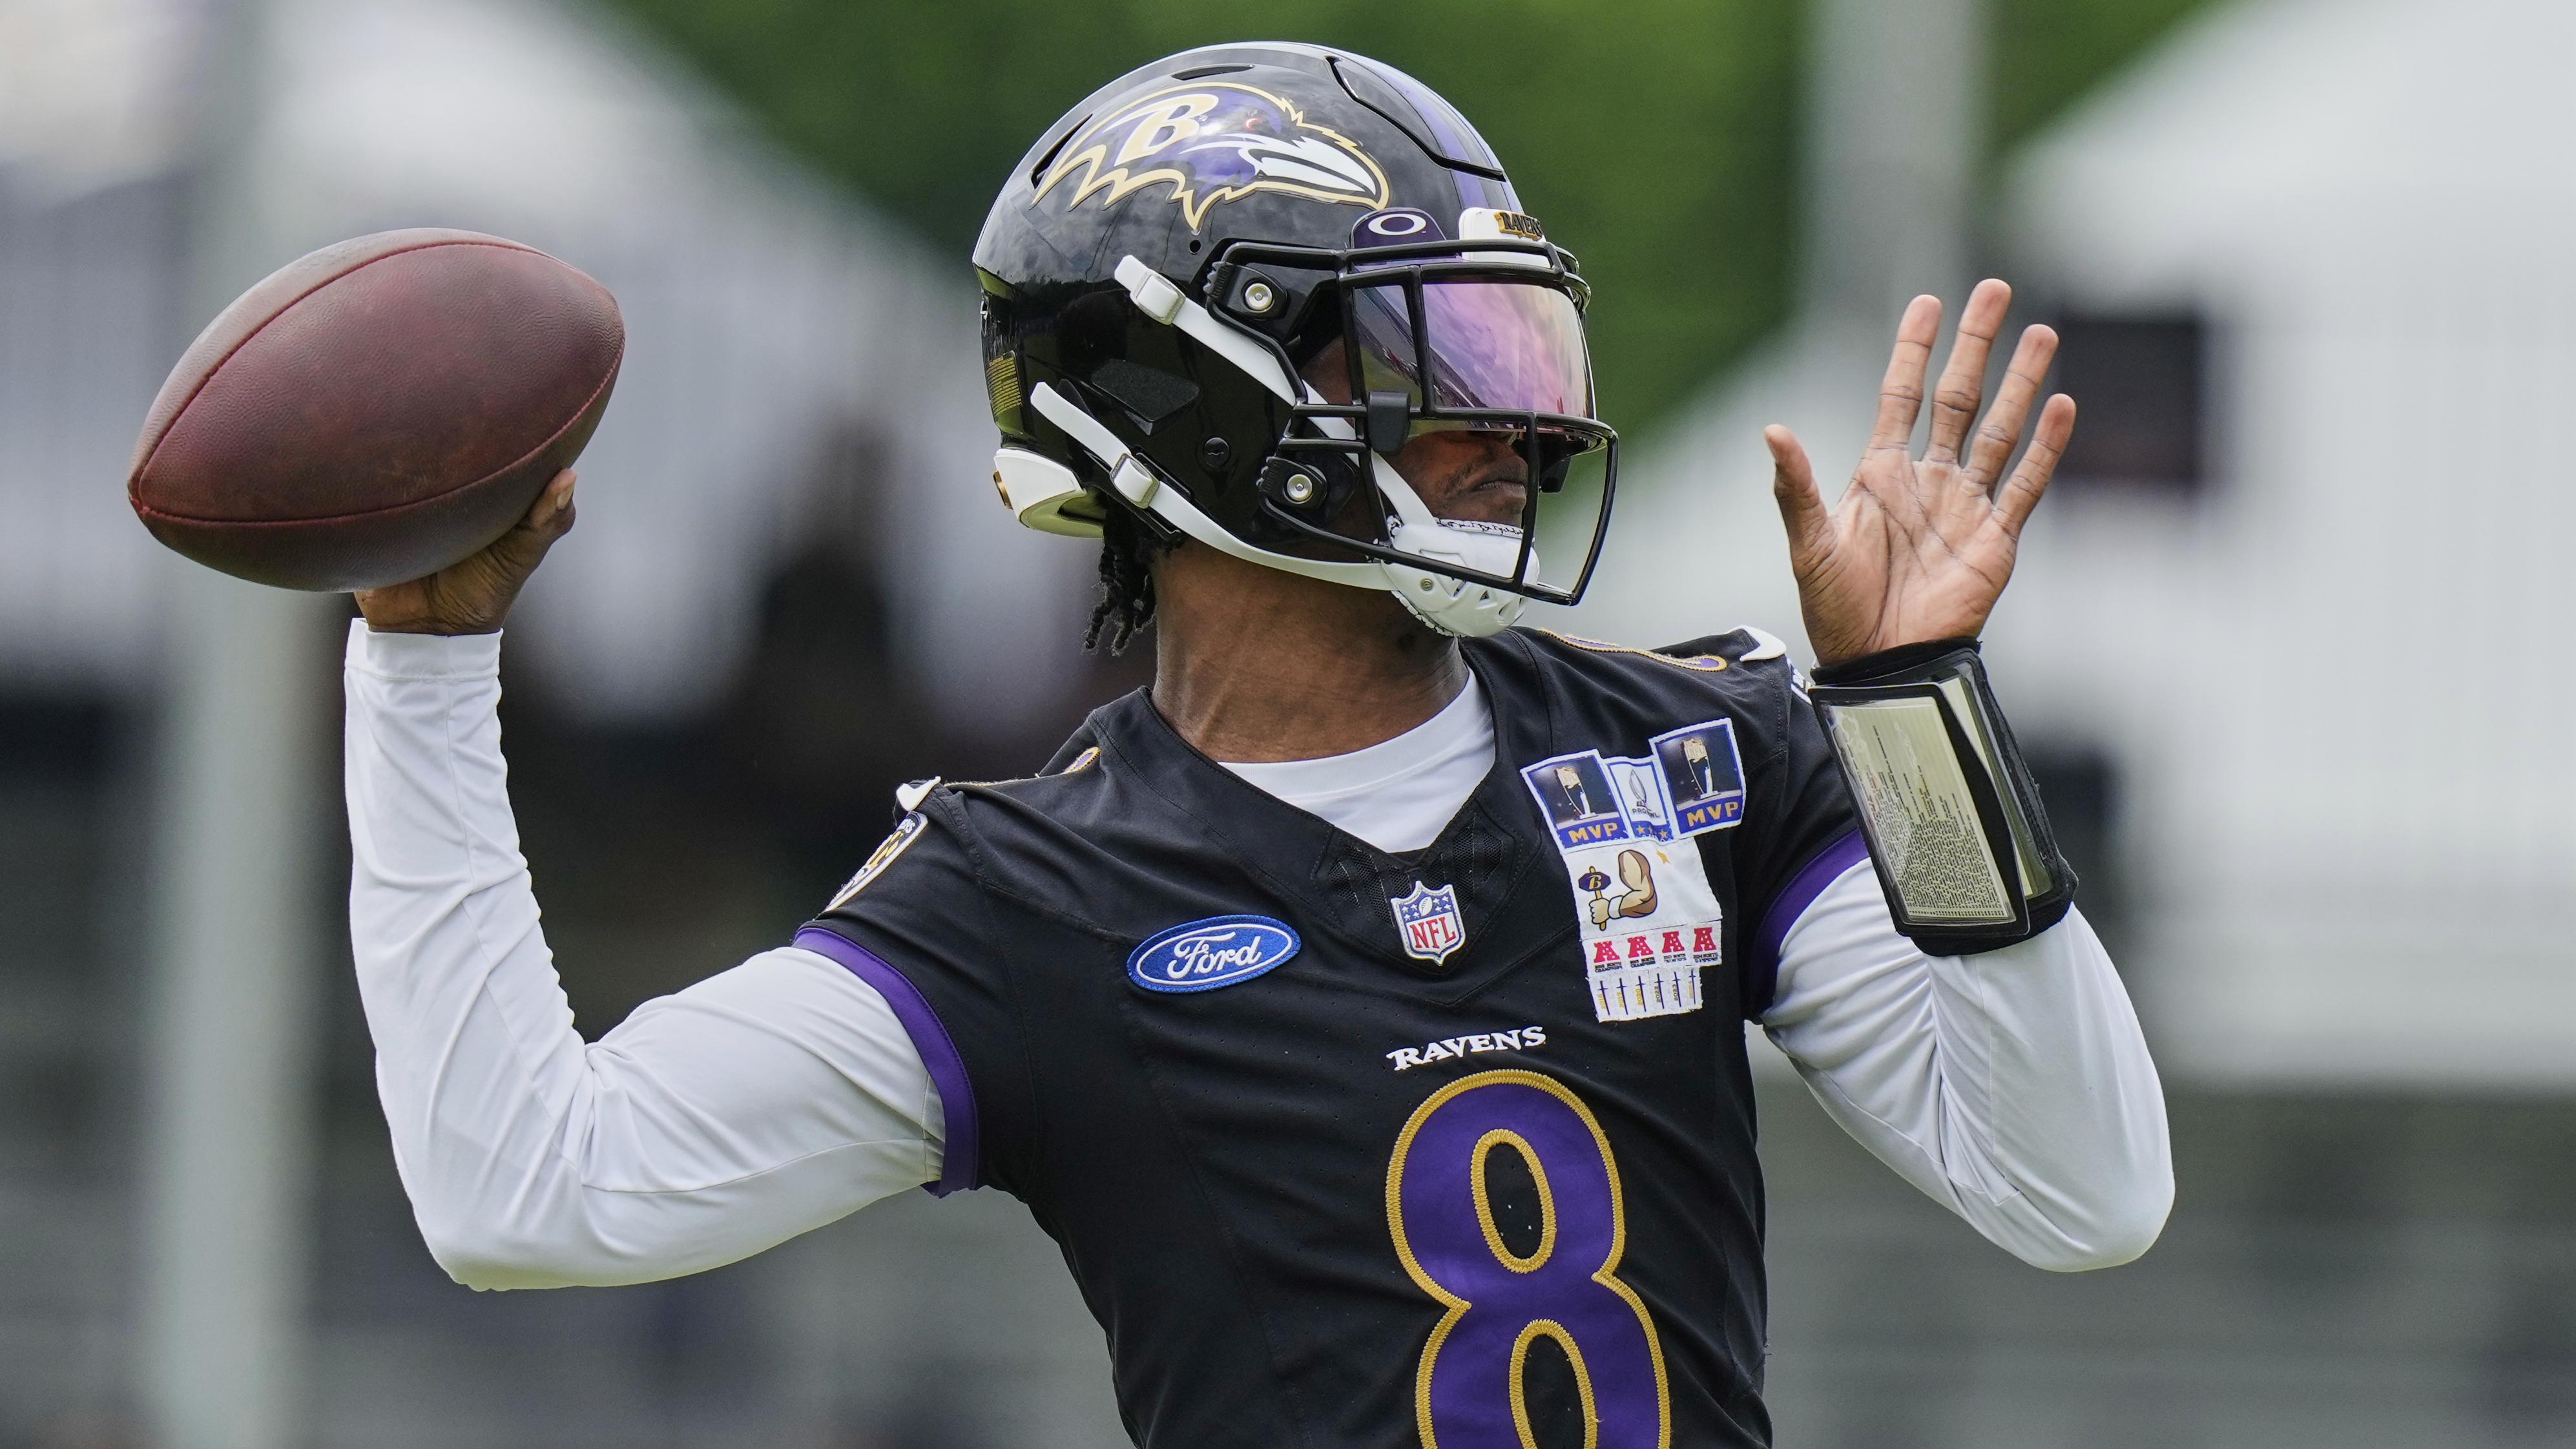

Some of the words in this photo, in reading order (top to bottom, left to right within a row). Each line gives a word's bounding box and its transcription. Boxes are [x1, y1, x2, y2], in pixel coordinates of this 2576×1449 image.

[1497, 212, 1544, 240] RAVENS
[1686, 801, 1739, 828] MVP
[1568, 822, 1619, 844] MVP
[1409, 916, 1457, 949] NFL
[1166, 931, 1262, 979] Ford
[1635, 988, 1644, 1006] 2020
[1386, 1026, 1546, 1071] RAVENS
[1386, 1069, 1671, 1449] 8
